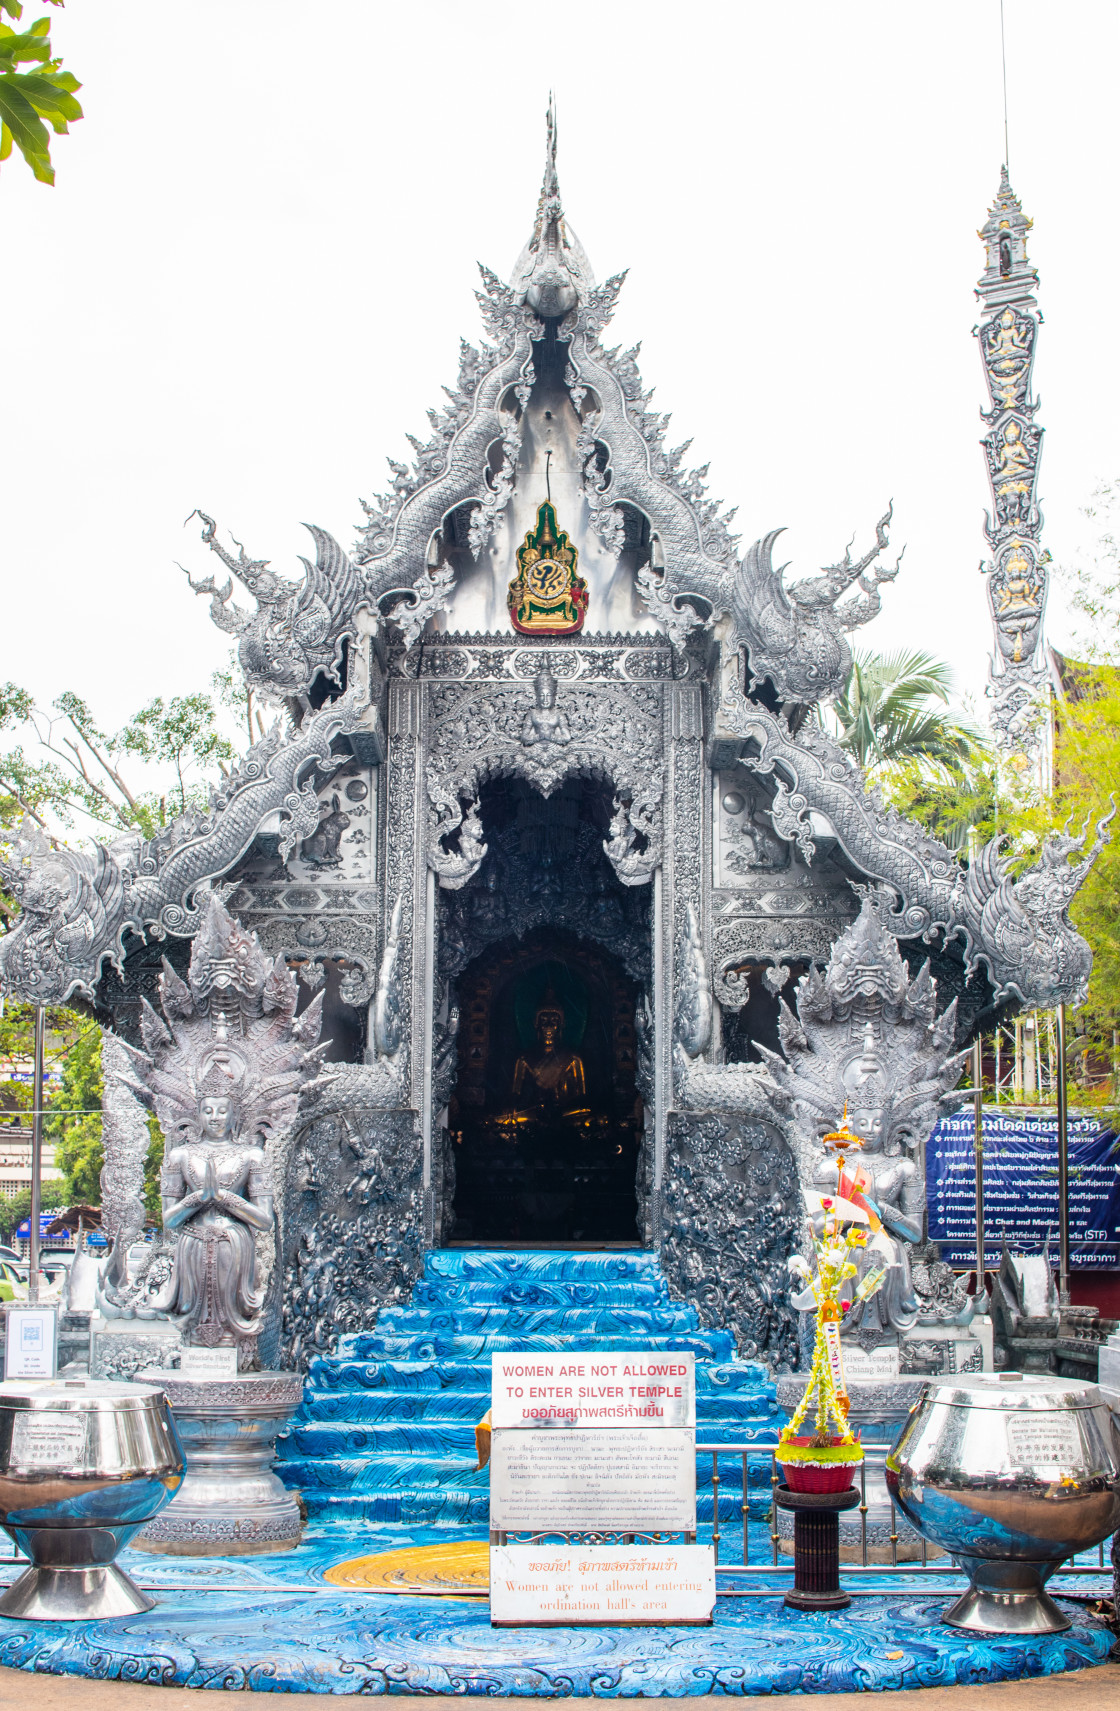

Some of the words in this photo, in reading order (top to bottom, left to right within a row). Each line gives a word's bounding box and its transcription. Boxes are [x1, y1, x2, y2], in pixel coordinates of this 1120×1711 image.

[1084, 1229, 1107, 1240] (STF)
[842, 1354, 865, 1362] Silver
[867, 1354, 896, 1364] Temple
[502, 1365, 555, 1377] WOMEN
[559, 1365, 585, 1377] ARE
[590, 1365, 618, 1377] NOT
[622, 1365, 687, 1377] ALLOWED
[846, 1365, 875, 1374] Chiang
[876, 1365, 893, 1373] Mai
[506, 1386, 525, 1398] TO
[529, 1386, 573, 1398] ENTER
[578, 1386, 624, 1398] SILVER
[629, 1386, 683, 1398] TEMPLE
[522, 1402, 664, 1421] ขออภัยสุภาพสตรีห้ามขึ้น
[528, 1558, 571, 1573] ขออภัย!
[505, 1580, 549, 1592] Women
[555, 1582, 575, 1592] are
[580, 1581, 599, 1592] not
[605, 1579, 649, 1592] allowed
[655, 1580, 703, 1594] entering
[540, 1597, 600, 1610] ordination
[606, 1597, 636, 1610] hall's
[642, 1600, 667, 1610] area
